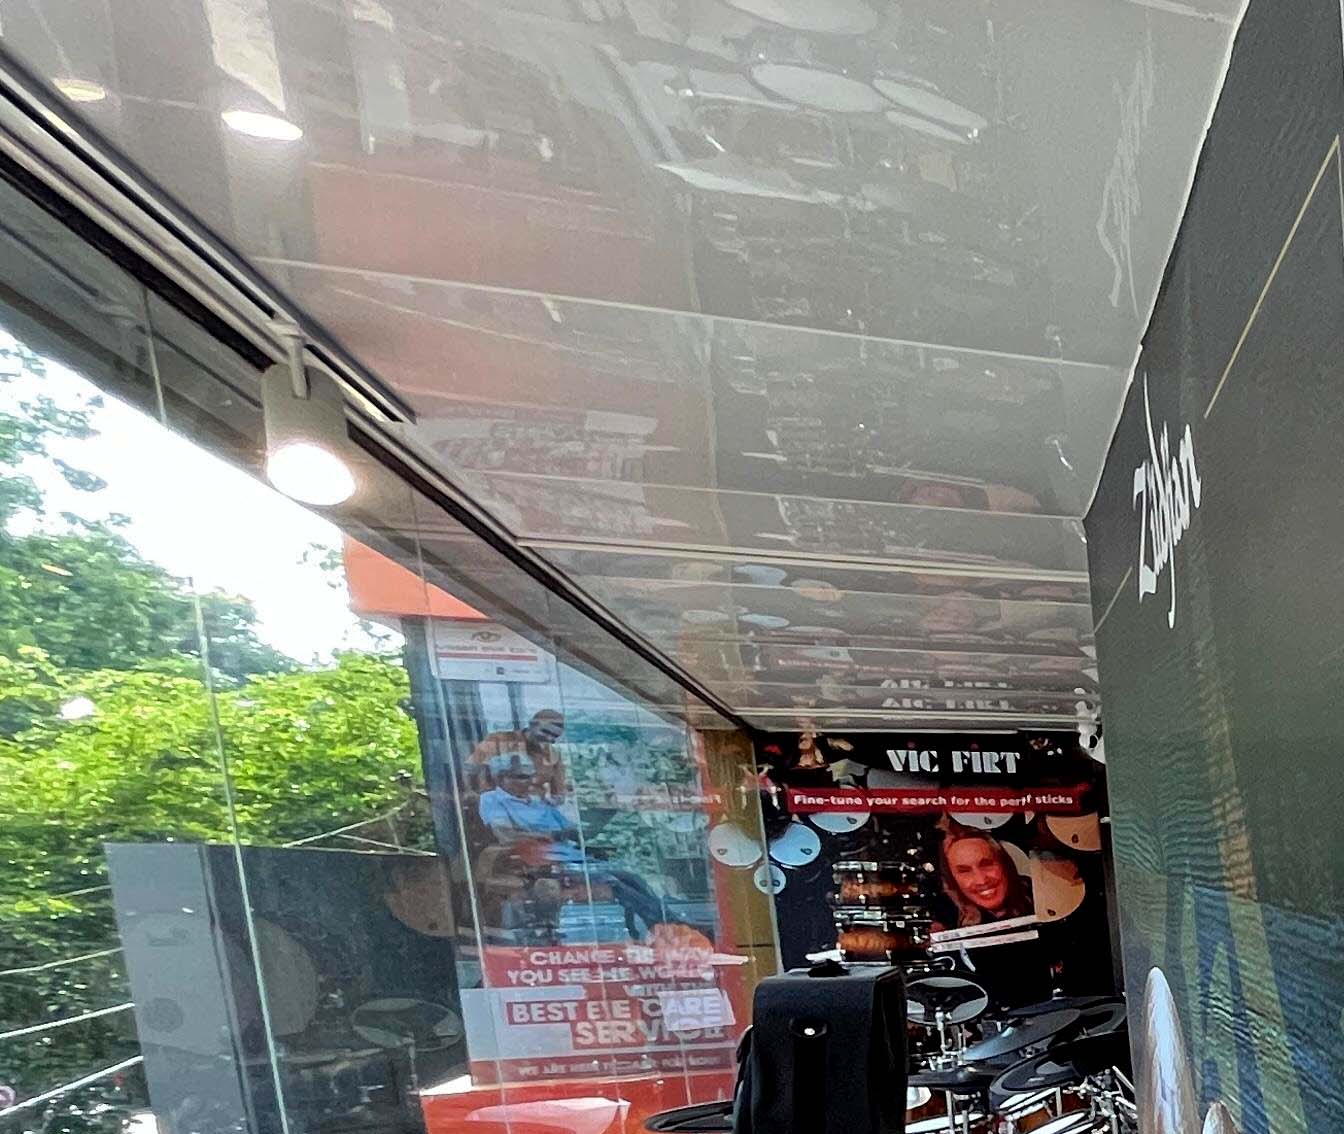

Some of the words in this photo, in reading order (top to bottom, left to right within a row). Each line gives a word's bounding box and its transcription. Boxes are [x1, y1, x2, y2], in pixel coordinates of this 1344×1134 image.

[886, 750, 940, 773] VIC
[793, 794, 863, 806] Fine-tune
[866, 796, 898, 808] your
[901, 795, 947, 807] search
[950, 795, 970, 807] for
[973, 794, 997, 807] the
[1034, 793, 1073, 805] sticks
[507, 968, 553, 984] YOU
[512, 1001, 578, 1023] BEST
[641, 996, 721, 1017] CARE
[575, 1014, 725, 1045] SERVICE
